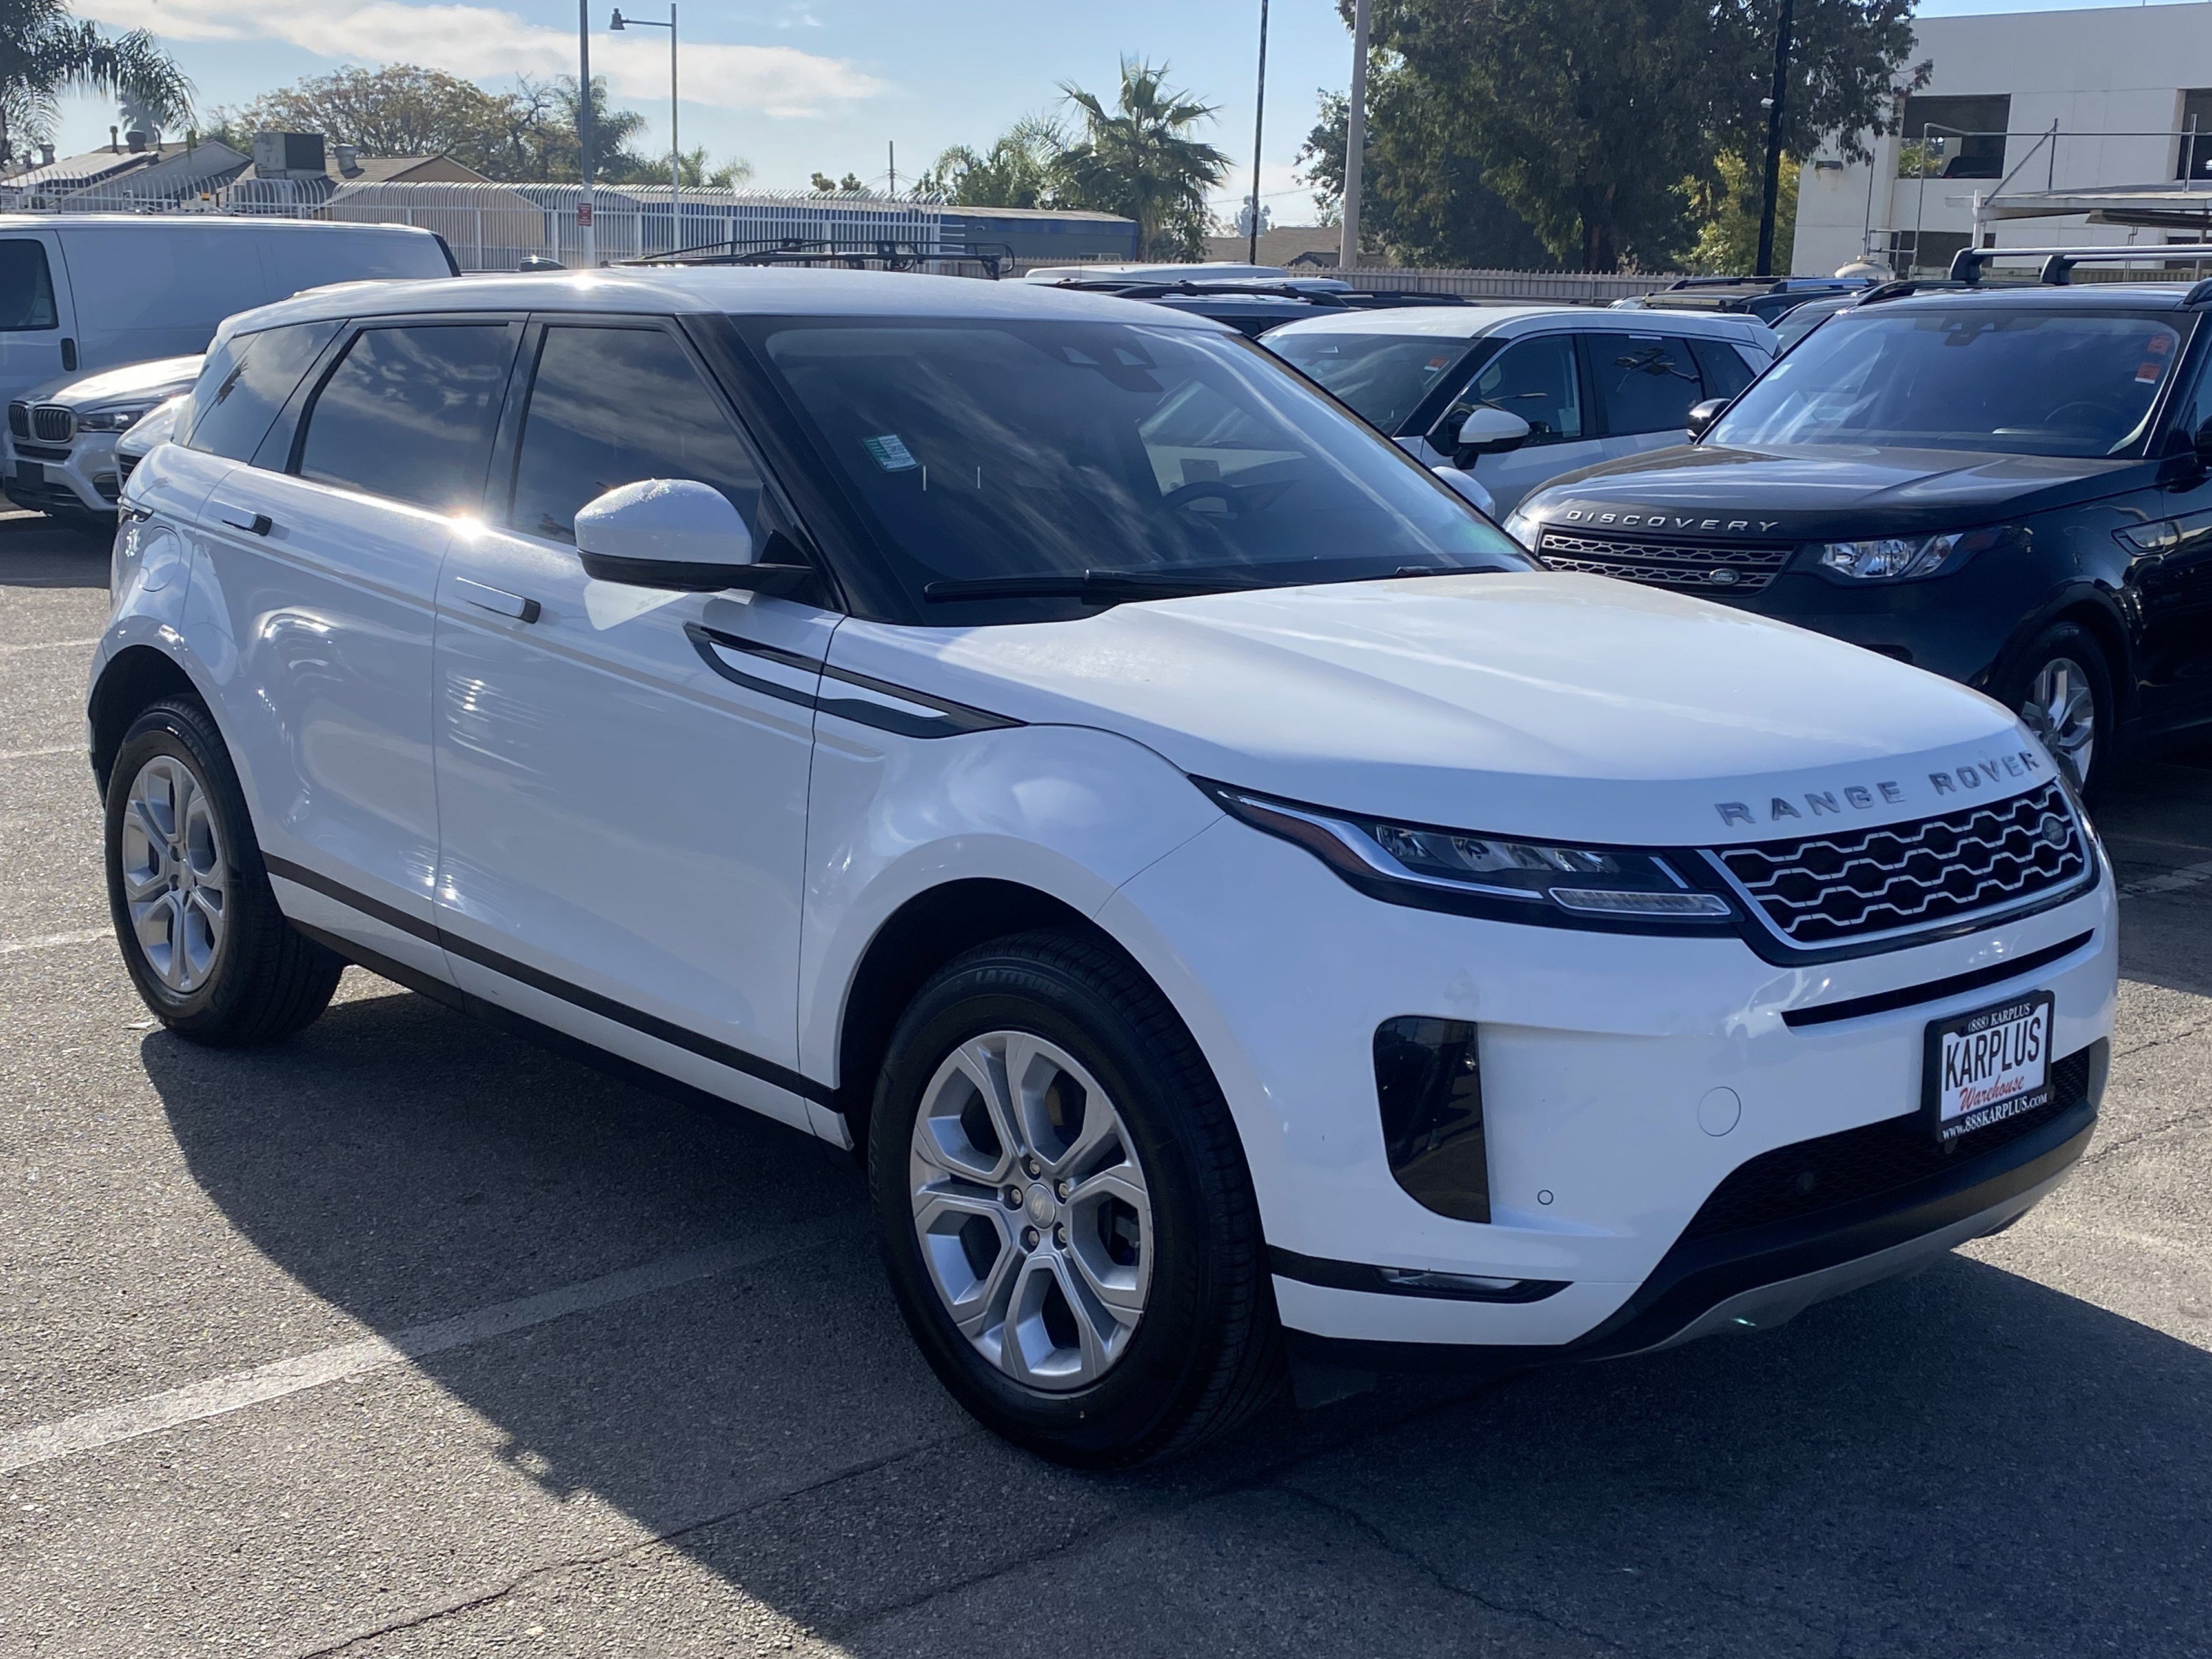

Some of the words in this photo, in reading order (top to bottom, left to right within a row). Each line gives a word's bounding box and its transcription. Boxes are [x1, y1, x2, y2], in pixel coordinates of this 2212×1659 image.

[1566, 511, 1779, 532] DISCOVERY
[1714, 780, 1906, 828] RANGE
[1929, 749, 2040, 795] ROVER
[975, 970, 1068, 1002] LATITUDE
[1991, 1003, 2031, 1026] KARPLUS
[1945, 1017, 2041, 1092] KARPLUS
[1959, 1074, 2024, 1112] Warehouse
